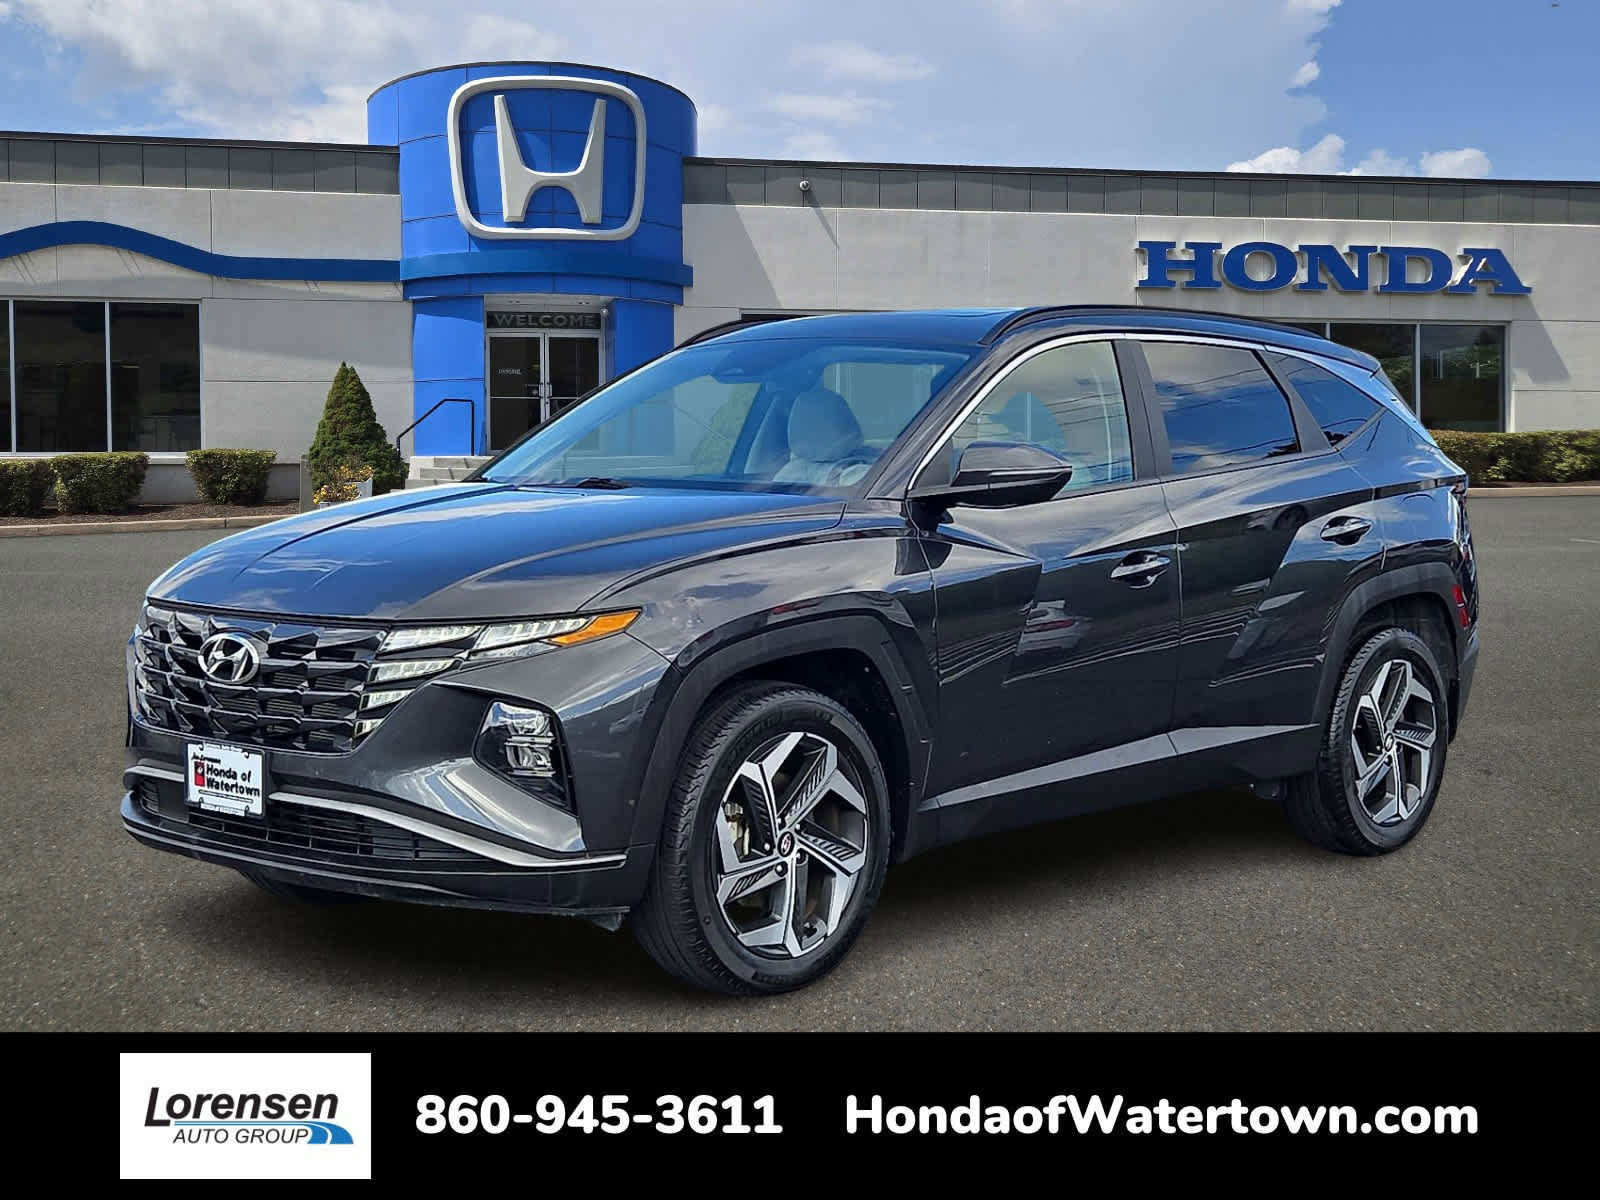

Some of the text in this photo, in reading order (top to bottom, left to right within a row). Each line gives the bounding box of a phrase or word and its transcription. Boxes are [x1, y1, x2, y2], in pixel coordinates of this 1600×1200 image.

[1136, 240, 1533, 296] HONDA
[494, 313, 595, 328] WELCOME
[206, 763, 252, 783] Honda of
[206, 777, 260, 798] Watertown
